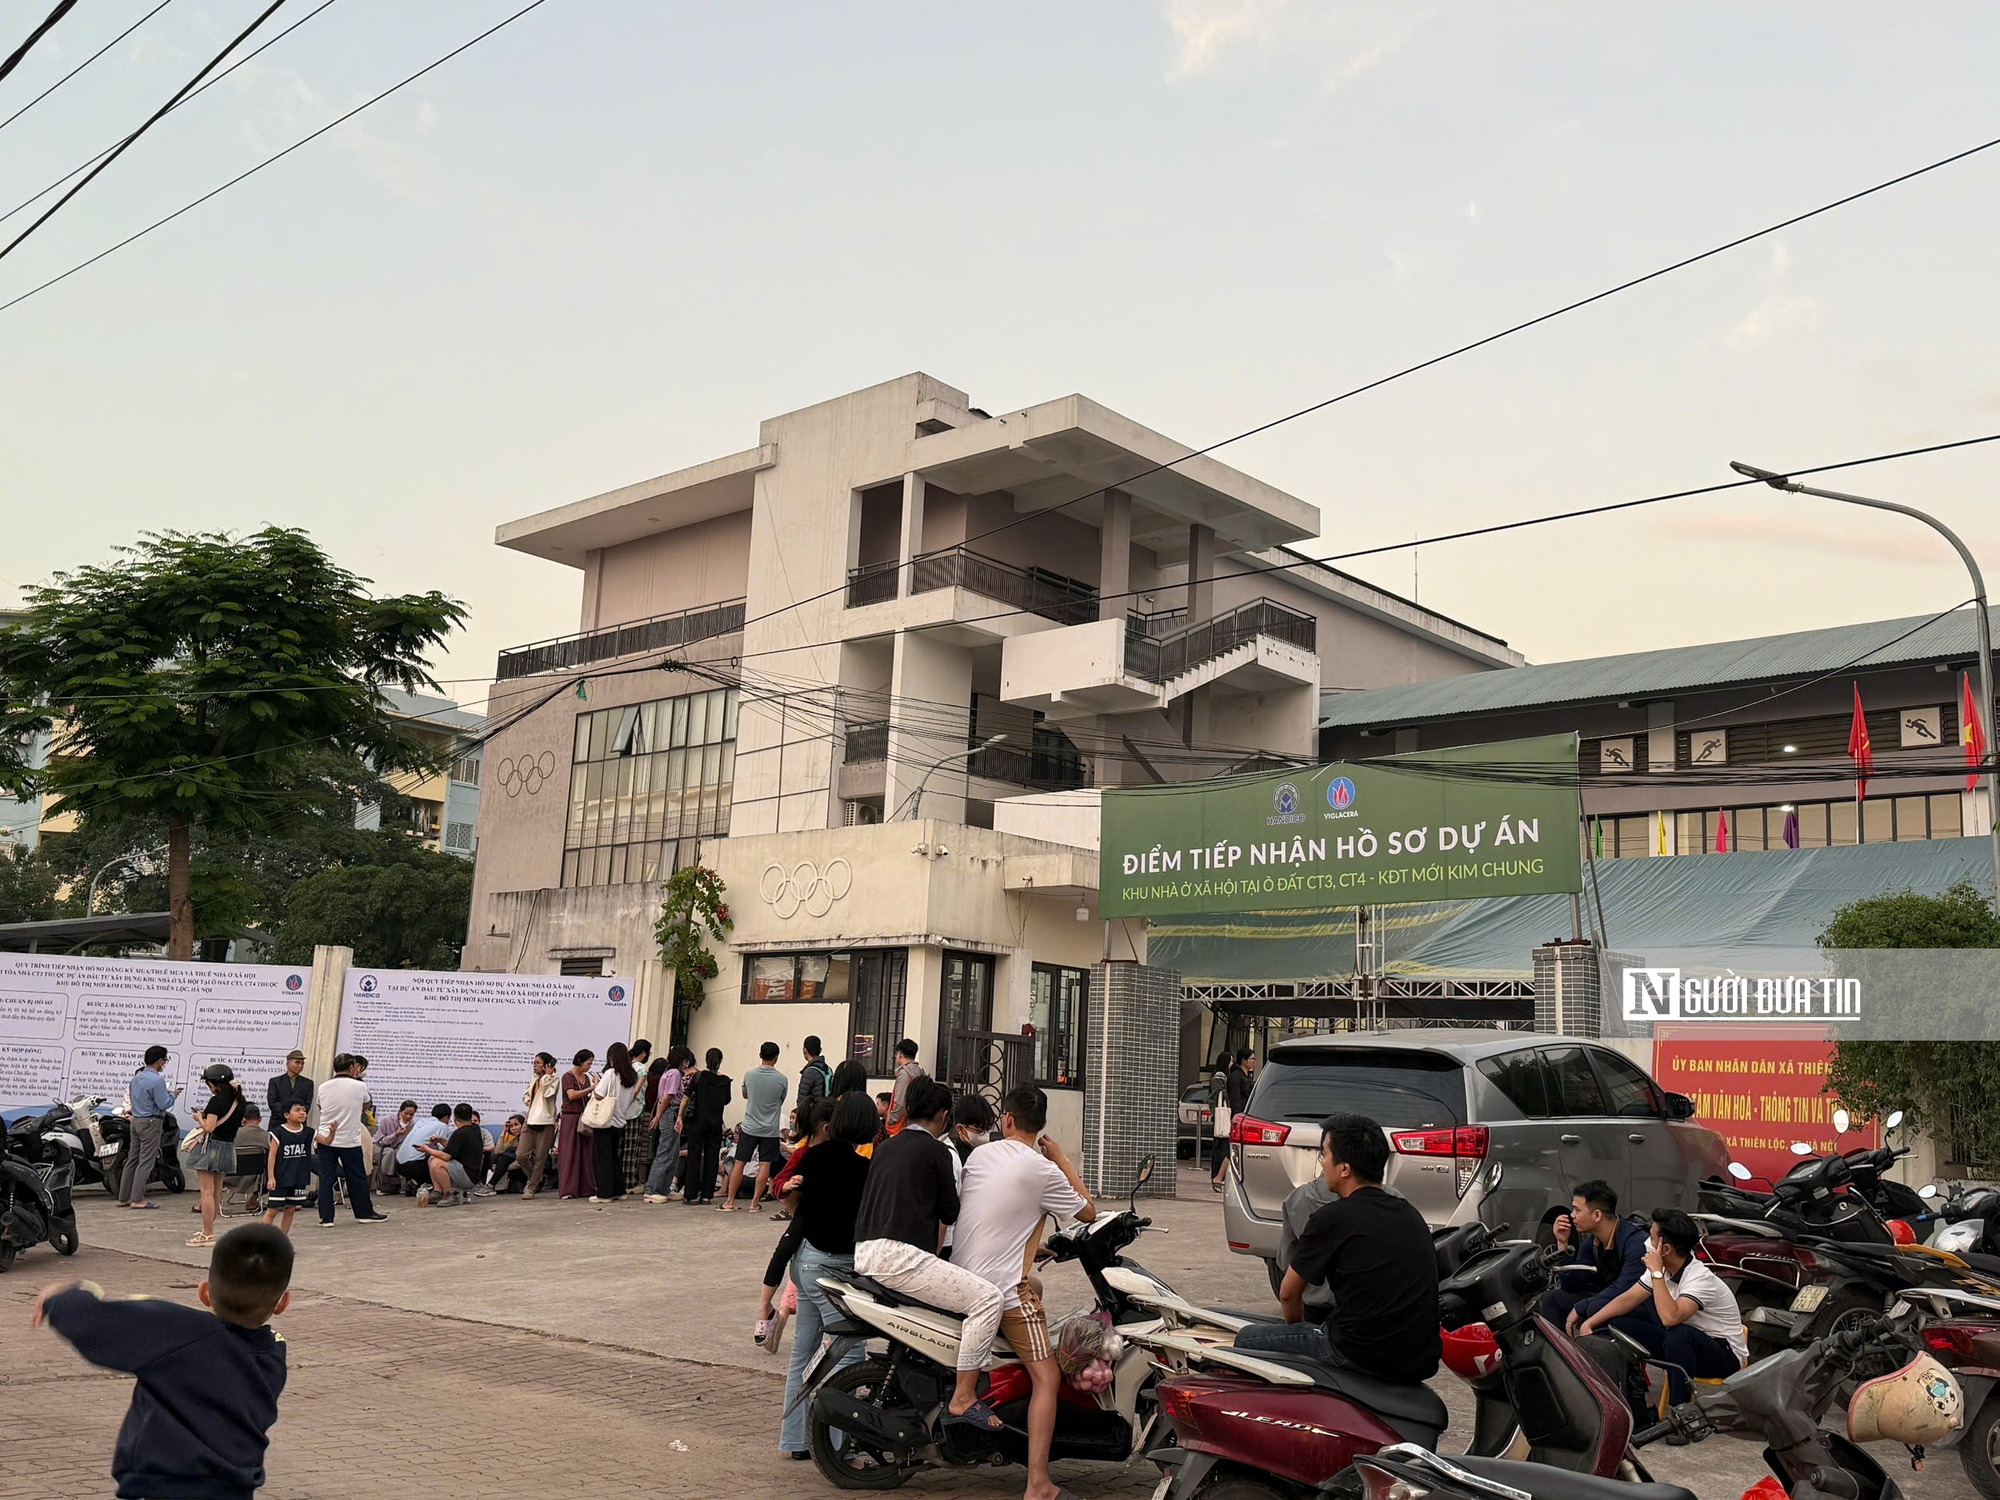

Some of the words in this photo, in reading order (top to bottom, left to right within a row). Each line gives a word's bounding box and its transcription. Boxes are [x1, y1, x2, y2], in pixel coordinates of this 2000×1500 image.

[1266, 814, 1306, 825] HANDICO
[1324, 810, 1359, 819] VIGLACERA
[1122, 843, 1182, 875] ĐIỂM
[1189, 839, 1242, 870] TIẾP
[1250, 835, 1326, 868] NHẬN
[1336, 827, 1378, 859] HỒ
[1387, 826, 1428, 855] SƠ
[1438, 820, 1487, 854] DỰ
[1494, 814, 1539, 847] ÁN
[1123, 888, 1148, 900] KHU
[1151, 882, 1179, 899] NHÀ
[1181, 881, 1192, 896] Ở
[1194, 881, 1212, 897] XÃ
[1214, 878, 1237, 897] HỘI
[1240, 880, 1260, 895] TẠI
[1263, 876, 1274, 892] Ô
[1277, 873, 1304, 891] ĐẤT
[1306, 874, 1336, 890] CT3,
[1340, 873, 1365, 887] CT4
[1379, 869, 1408, 884] KĐT
[1412, 864, 1443, 881] MỚI
[1448, 864, 1477, 879] KIM
[1482, 859, 1544, 877] CHUNG
[1672, 1055, 1687, 1071] ỦY
[1689, 1060, 1712, 1072] BAN
[1716, 1058, 1748, 1073] NHÂN
[1751, 1059, 1775, 1074] DÂN
[1779, 1060, 1794, 1074] XÃ
[1713, 1089, 1731, 1120] VĂN
[1733, 1090, 1751, 1121] HOÁ
[1760, 1091, 1791, 1122] THÔNG
[1793, 1097, 1809, 1123] TIN
[1812, 1094, 1823, 1123] VÀ
[1726, 1136, 1737, 1147] XÃ
[1740, 1136, 1765, 1148] THIÊN
[887, 1322, 955, 1350] AIRBLADE
